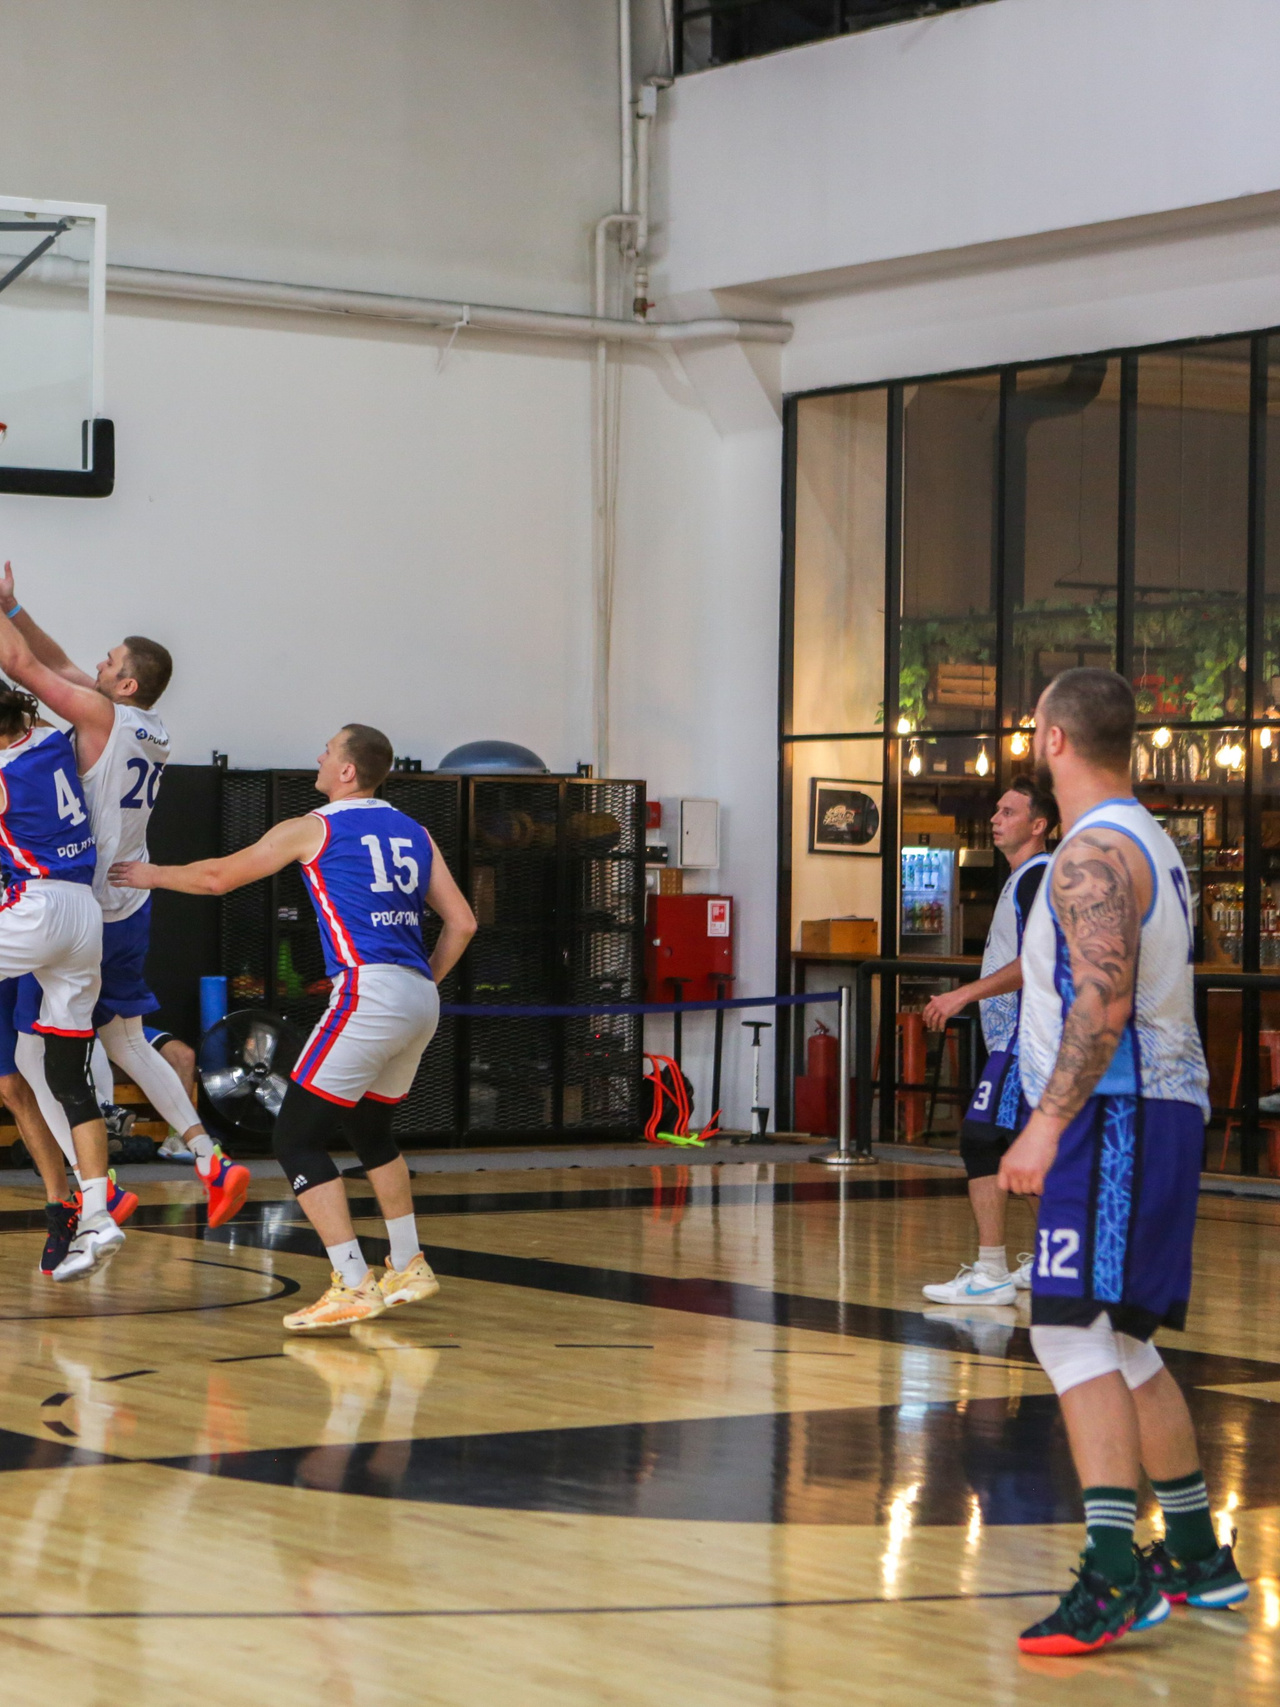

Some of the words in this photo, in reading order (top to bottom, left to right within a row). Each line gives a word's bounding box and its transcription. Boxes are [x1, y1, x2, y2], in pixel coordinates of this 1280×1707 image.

[53, 767, 88, 827] 4
[360, 834, 419, 895] 15
[972, 1080, 993, 1111] 3
[1037, 1228, 1081, 1279] 12
